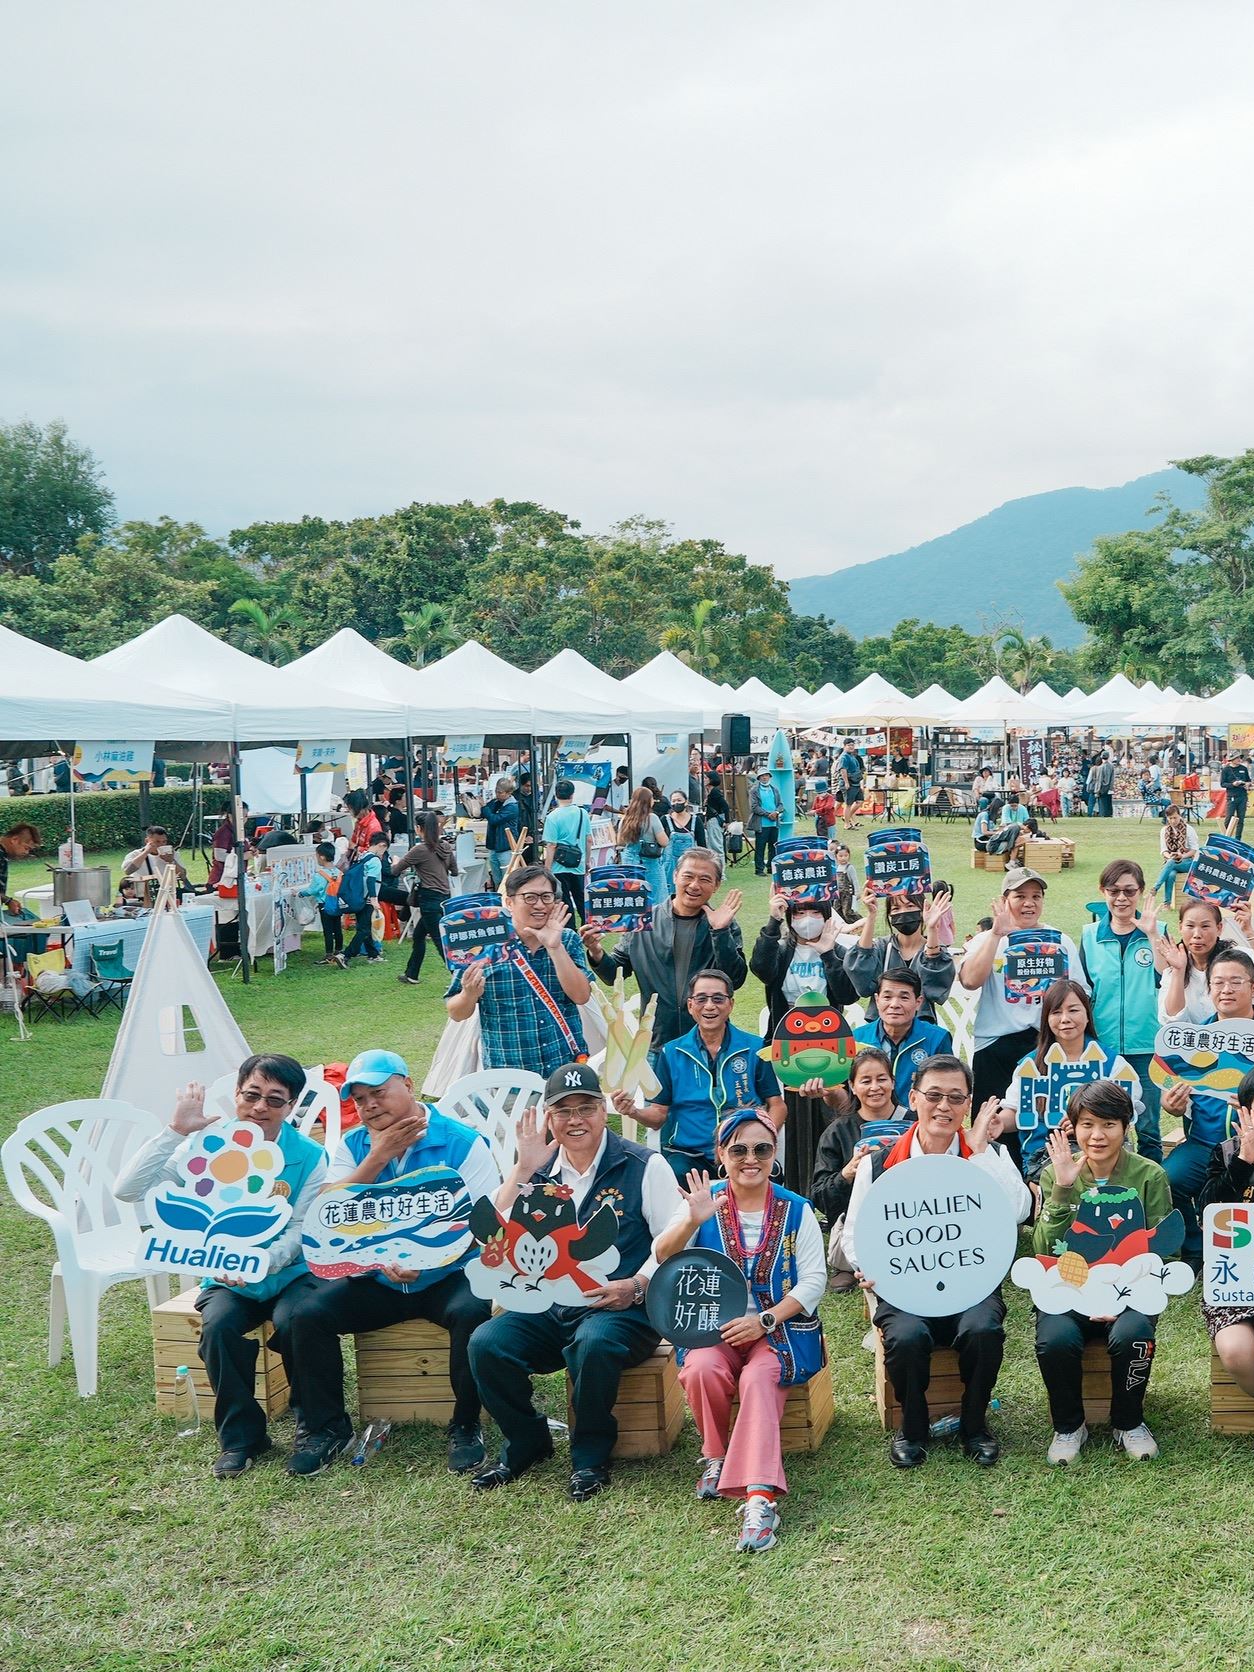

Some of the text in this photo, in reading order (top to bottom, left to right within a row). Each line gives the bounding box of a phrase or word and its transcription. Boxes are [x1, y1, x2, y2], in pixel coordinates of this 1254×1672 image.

[782, 866, 827, 882] 德森農莊
[592, 895, 646, 909] 富里鄉農會
[1017, 958, 1055, 969] 原生好物
[1017, 968, 1055, 976] 股份有限公司
[324, 1192, 450, 1226] 花蓮農村好生活
[884, 1193, 983, 1221] HUALIEN
[887, 1223, 962, 1249] GOOD
[144, 1237, 260, 1275] Hualien
[890, 1248, 985, 1275] SAUCES
[676, 1265, 722, 1297] 花蓮
[674, 1300, 722, 1333] 好釀
[1126, 1340, 1155, 1391] FILA
